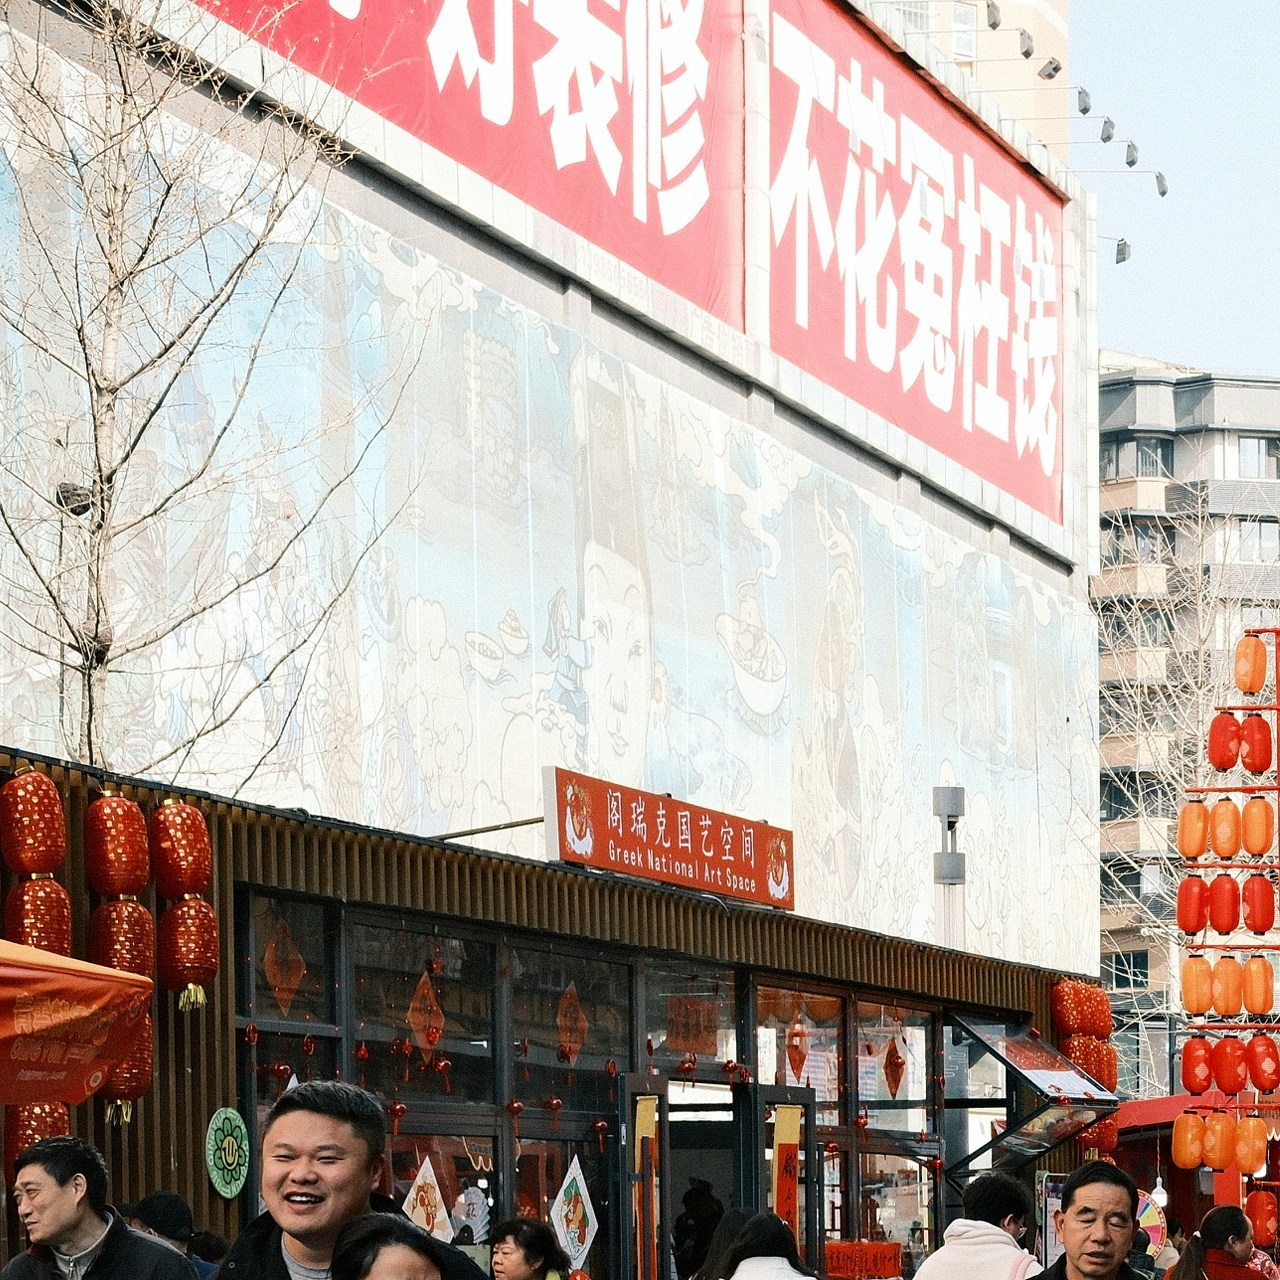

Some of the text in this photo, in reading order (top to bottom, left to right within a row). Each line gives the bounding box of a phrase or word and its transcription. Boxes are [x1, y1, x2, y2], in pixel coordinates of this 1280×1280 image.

[770, 11, 1058, 477] 不花冤枉钱
[607, 788, 756, 869] 阁瑞克国艺空间
[609, 839, 756, 894] Greek National Art Space
